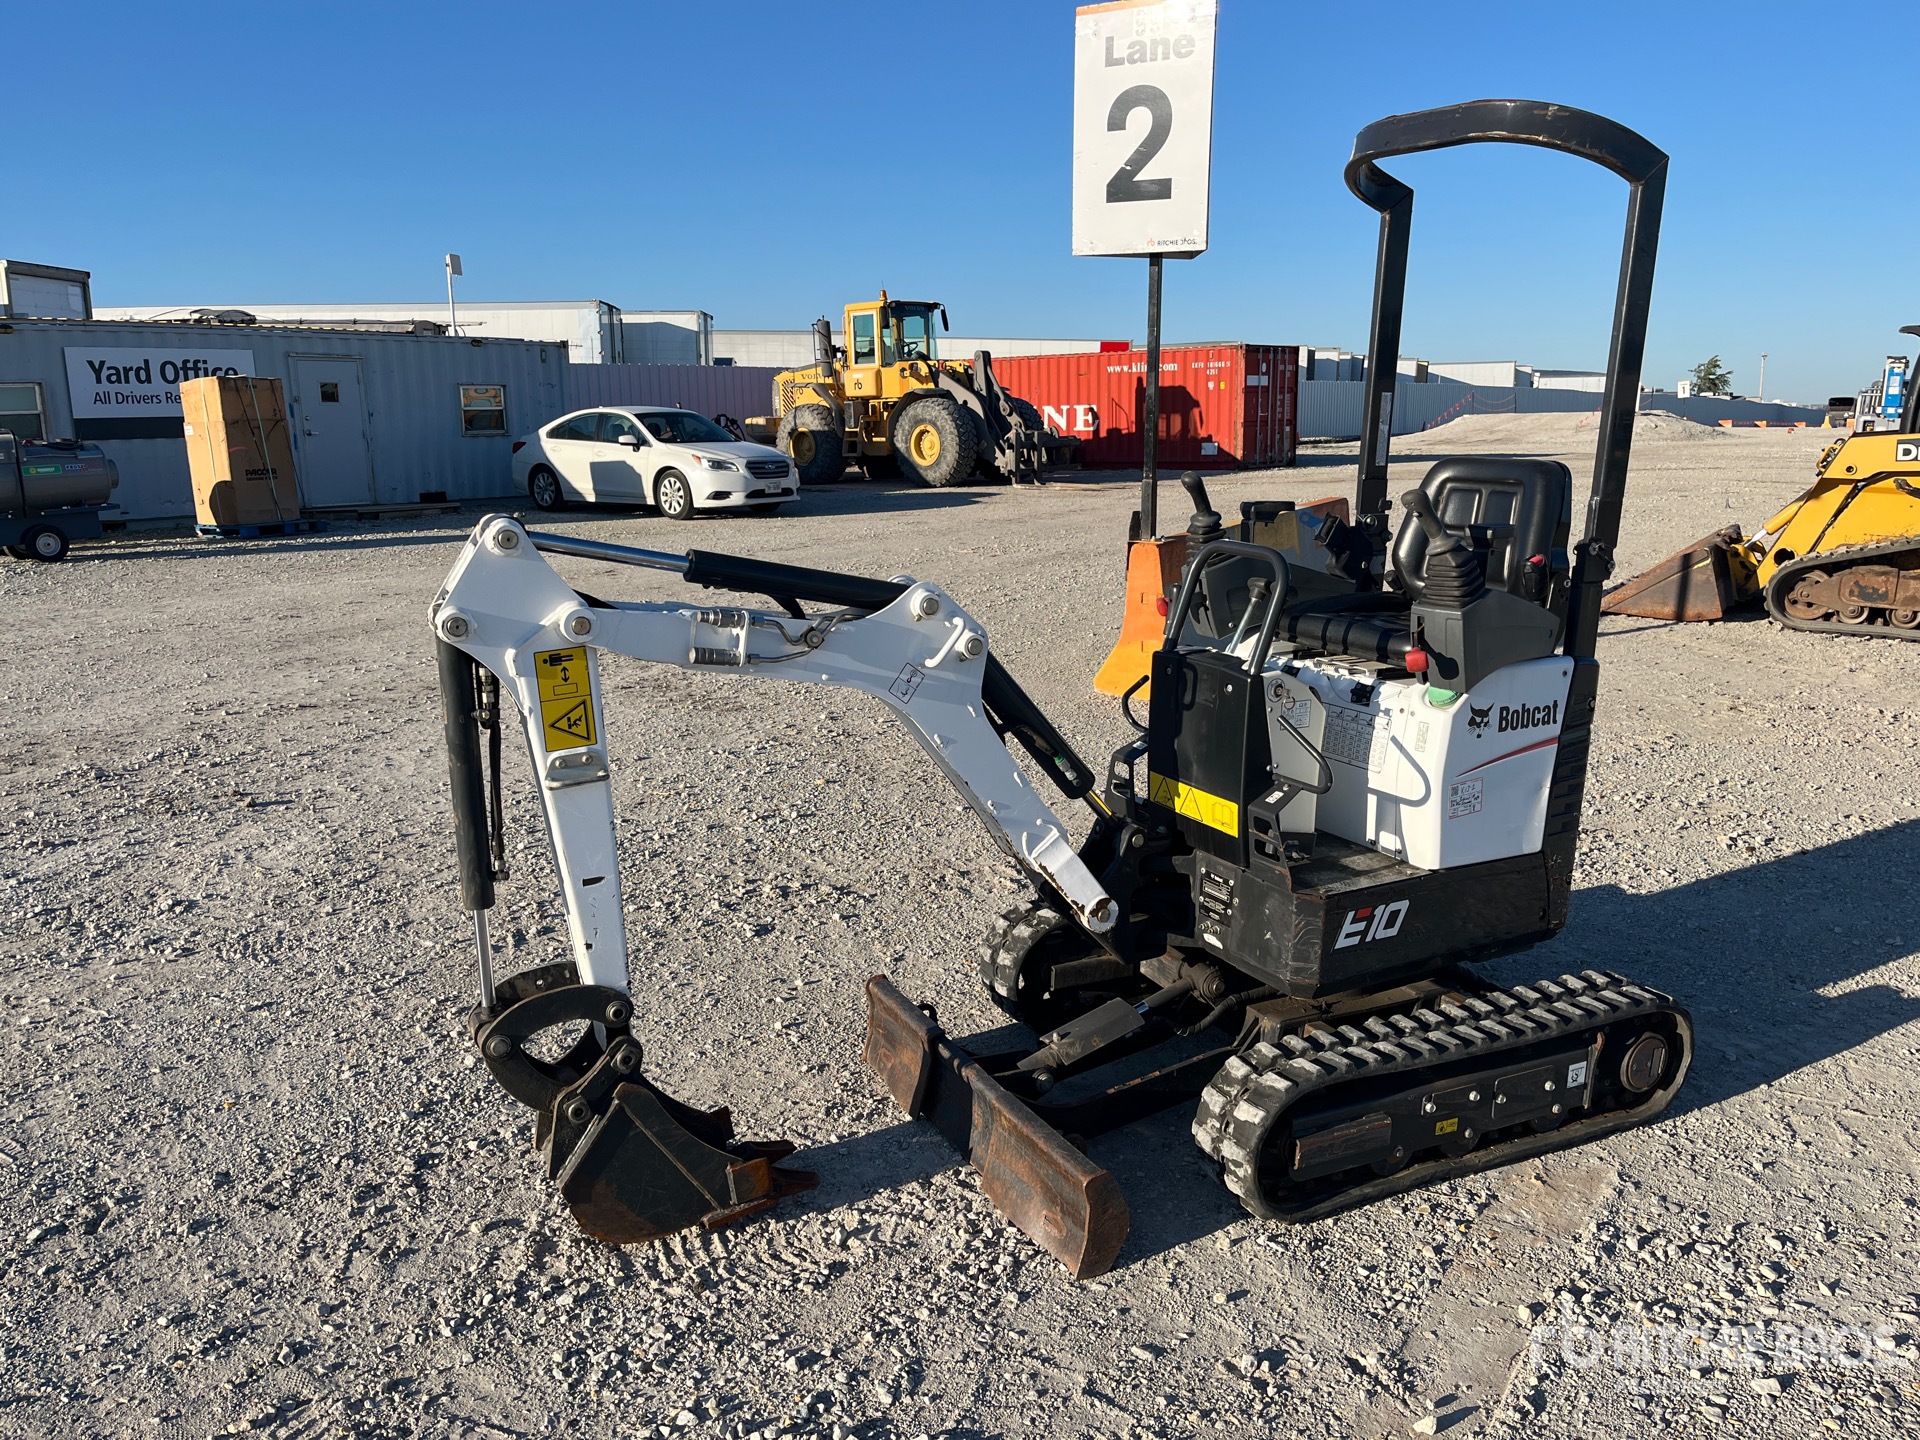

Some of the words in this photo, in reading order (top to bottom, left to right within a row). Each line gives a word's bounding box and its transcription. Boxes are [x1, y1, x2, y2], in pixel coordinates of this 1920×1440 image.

[1104, 34, 1196, 68] Lane
[1105, 84, 1173, 204] 2
[86, 359, 152, 385] Yard
[93, 391, 112, 405] All
[115, 391, 162, 405] Drivers
[165, 391, 182, 404] Re
[1038, 404, 1099, 431] NE
[1897, 444, 1920, 460] D
[1497, 699, 1559, 733] Bobcat
[1333, 899, 1410, 950] E10
